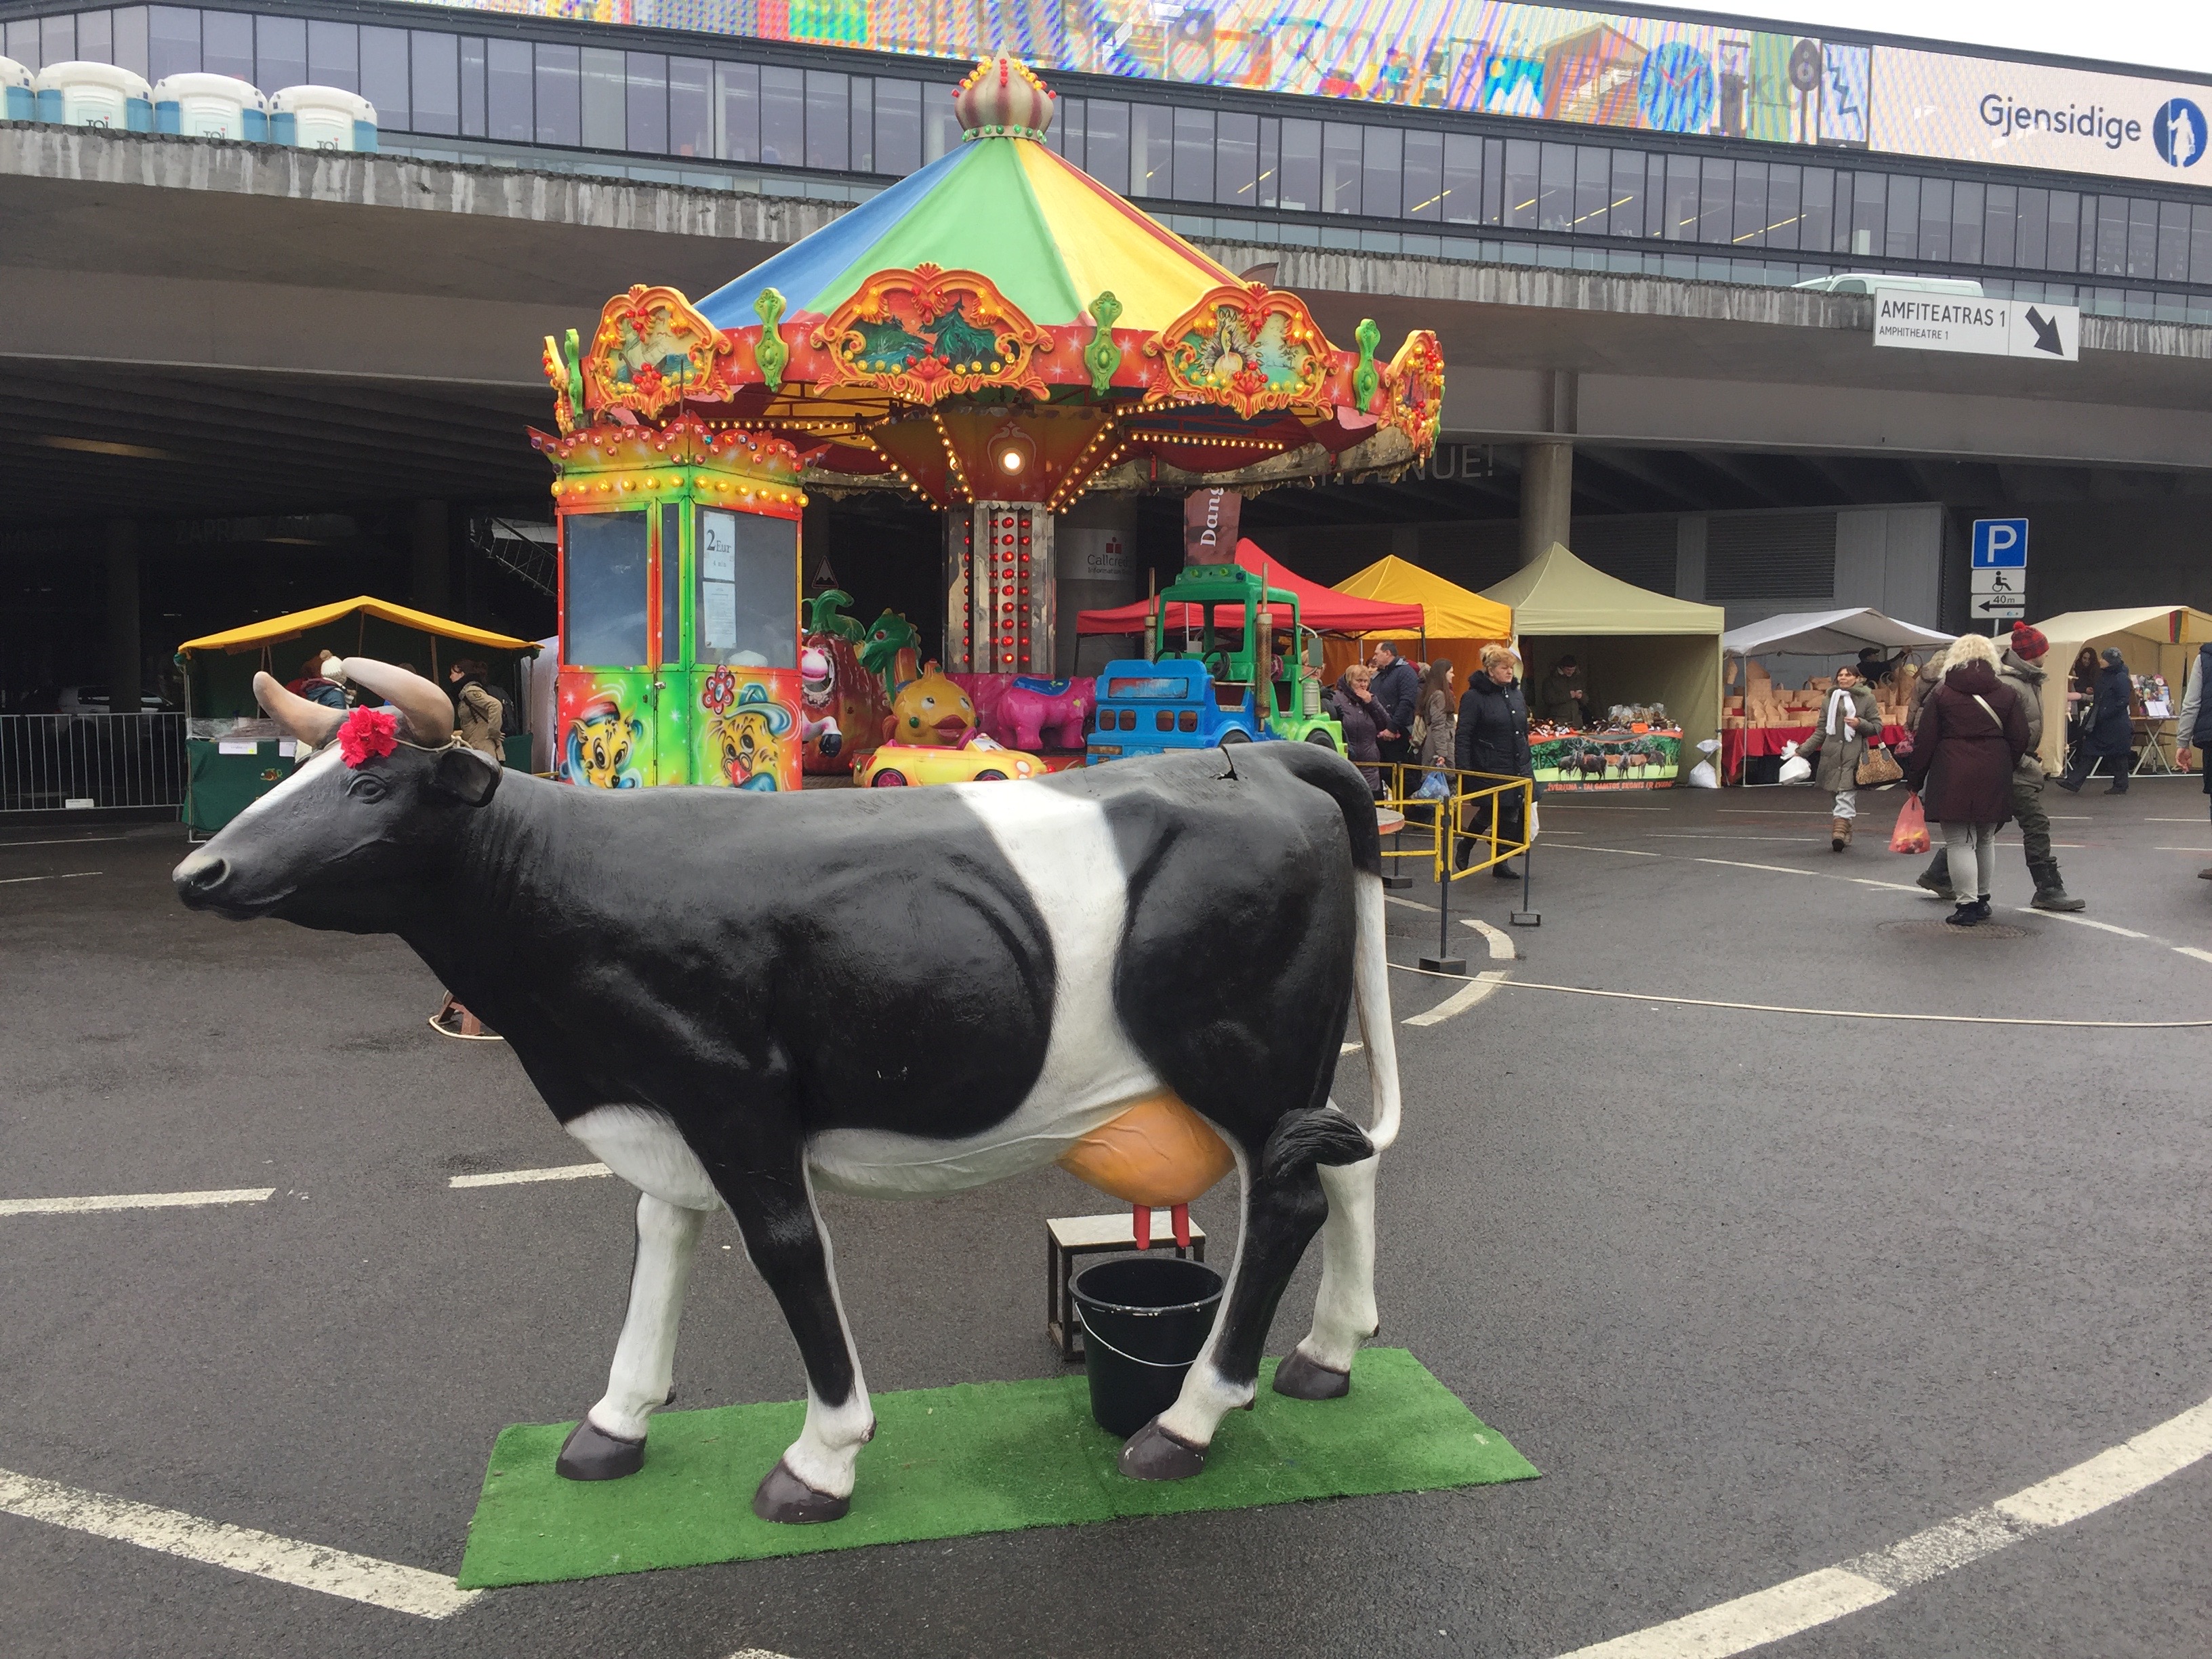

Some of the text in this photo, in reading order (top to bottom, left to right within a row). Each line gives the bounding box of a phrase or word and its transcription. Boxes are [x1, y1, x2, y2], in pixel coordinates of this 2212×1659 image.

[1980, 94, 2142, 148] Gjensidige
[1881, 300, 2006, 327] AMFITEATRAS 1
[1879, 326, 1949, 340] AMPHITHEATRE 1
[707, 529, 732, 553] 2 Eur
[1988, 525, 2017, 562] P
